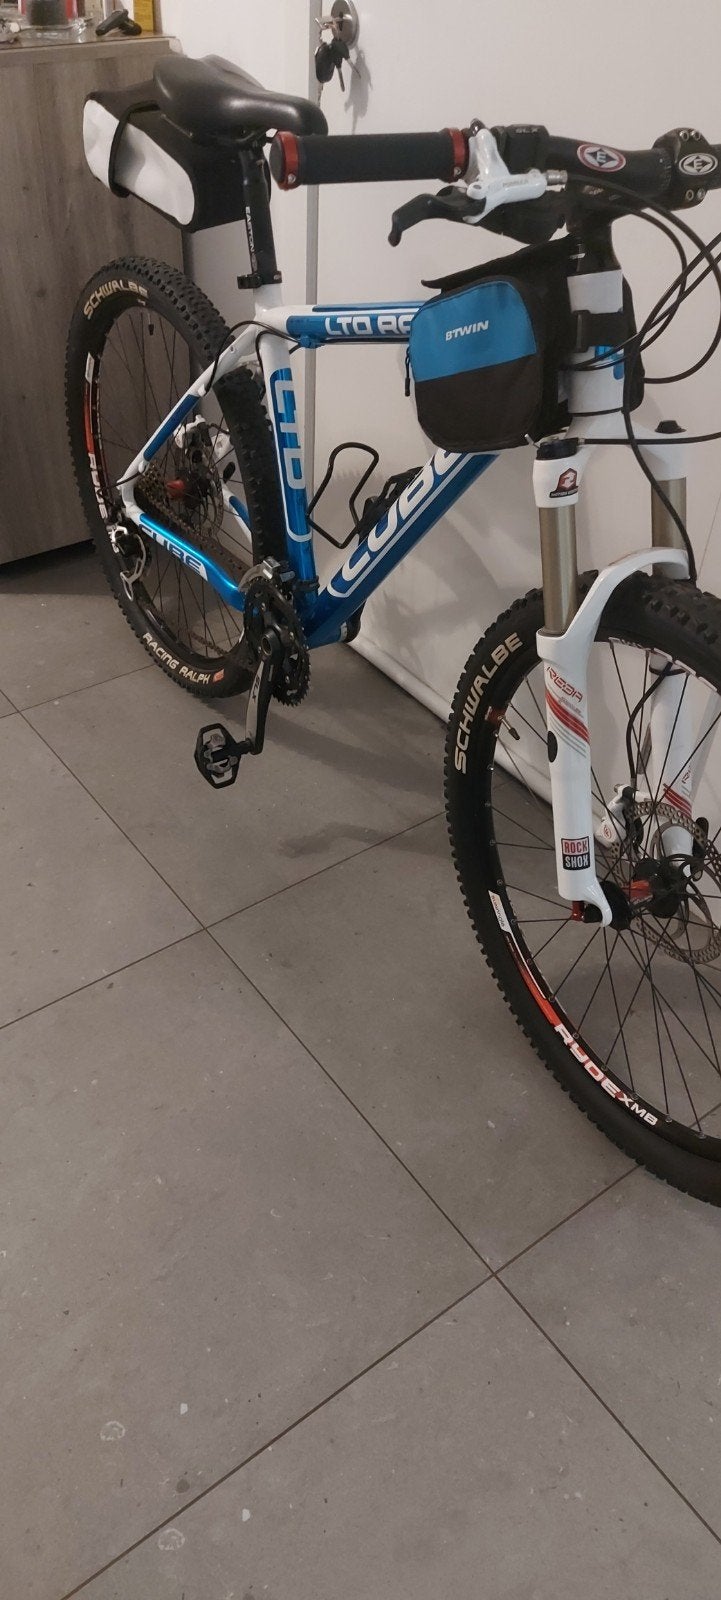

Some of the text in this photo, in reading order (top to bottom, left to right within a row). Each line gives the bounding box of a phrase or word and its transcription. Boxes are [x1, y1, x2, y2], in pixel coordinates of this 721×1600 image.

[83, 279, 148, 320] SCHWALBE
[142, 632, 211, 685] RACING RALPH
[546, 666, 583, 702] REBA
[454, 632, 523, 775] SCHWALBE
[564, 840, 588, 854] ROCK
[564, 854, 589, 868] SHOX
[618, 1093, 659, 1126] XMB
